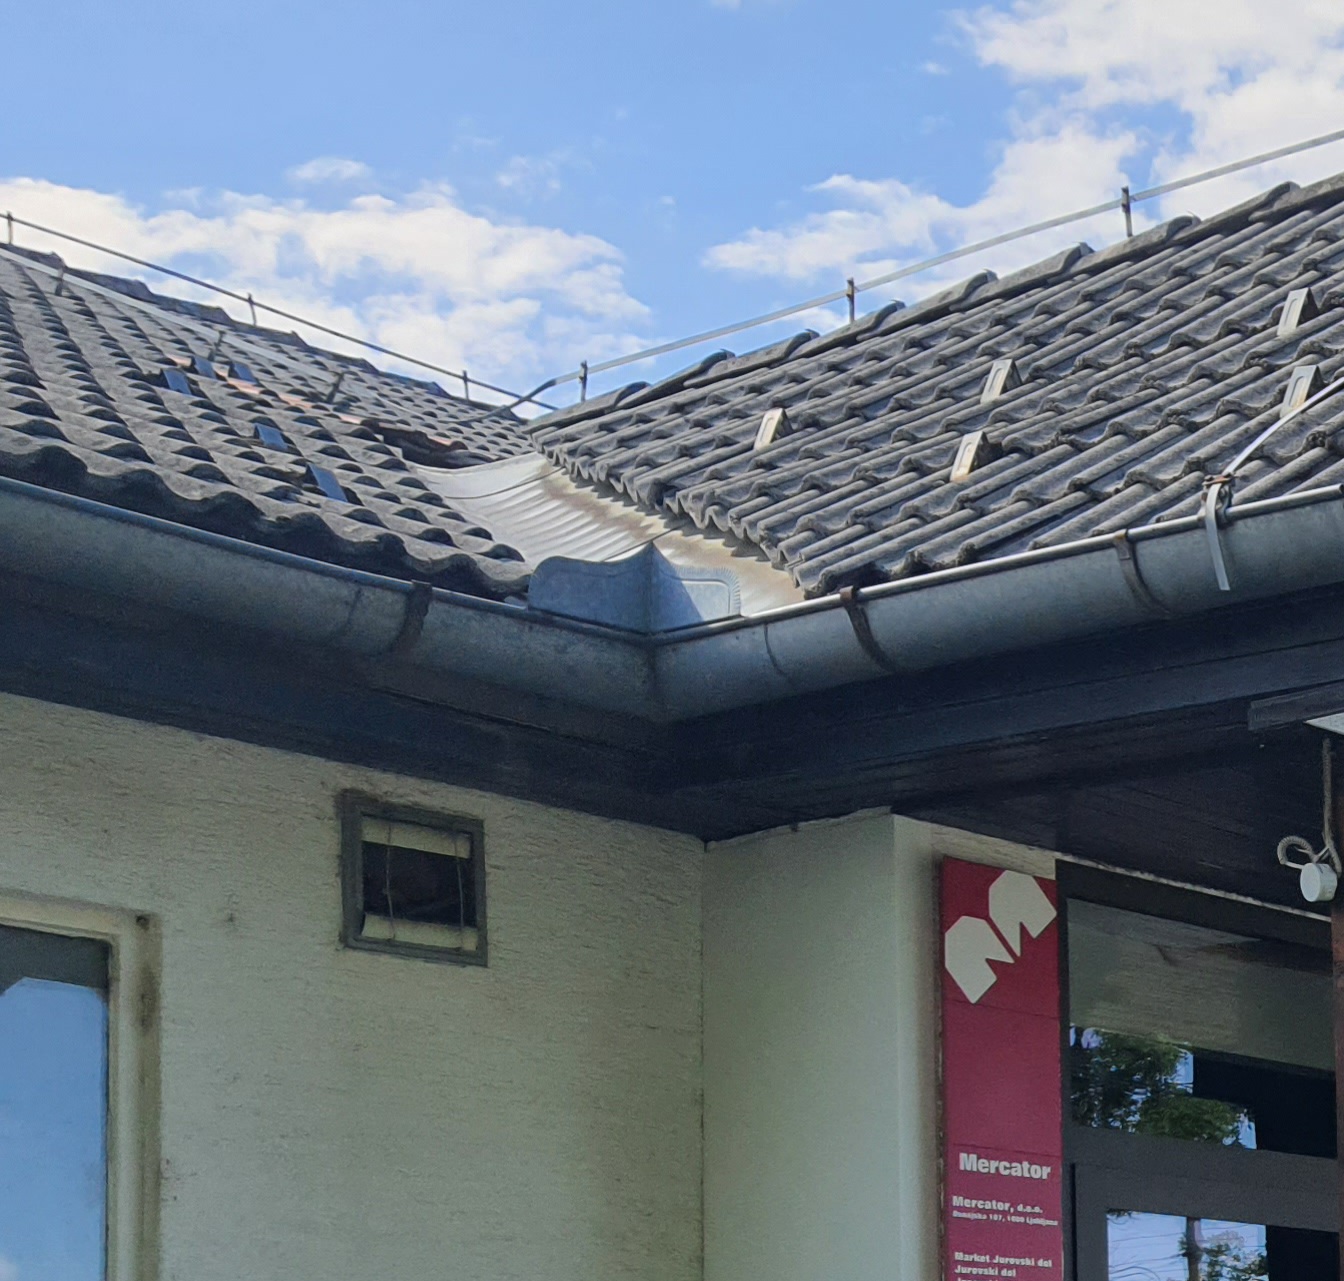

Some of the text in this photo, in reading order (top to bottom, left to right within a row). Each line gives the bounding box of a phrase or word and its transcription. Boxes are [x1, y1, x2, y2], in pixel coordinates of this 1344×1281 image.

[959, 1152, 1052, 1180] Mercator
[952, 1195, 1014, 1213] Mercator,
[954, 1251, 1052, 1268] Market Jurovski dol
[954, 1265, 1017, 1277] Jurovski dol
